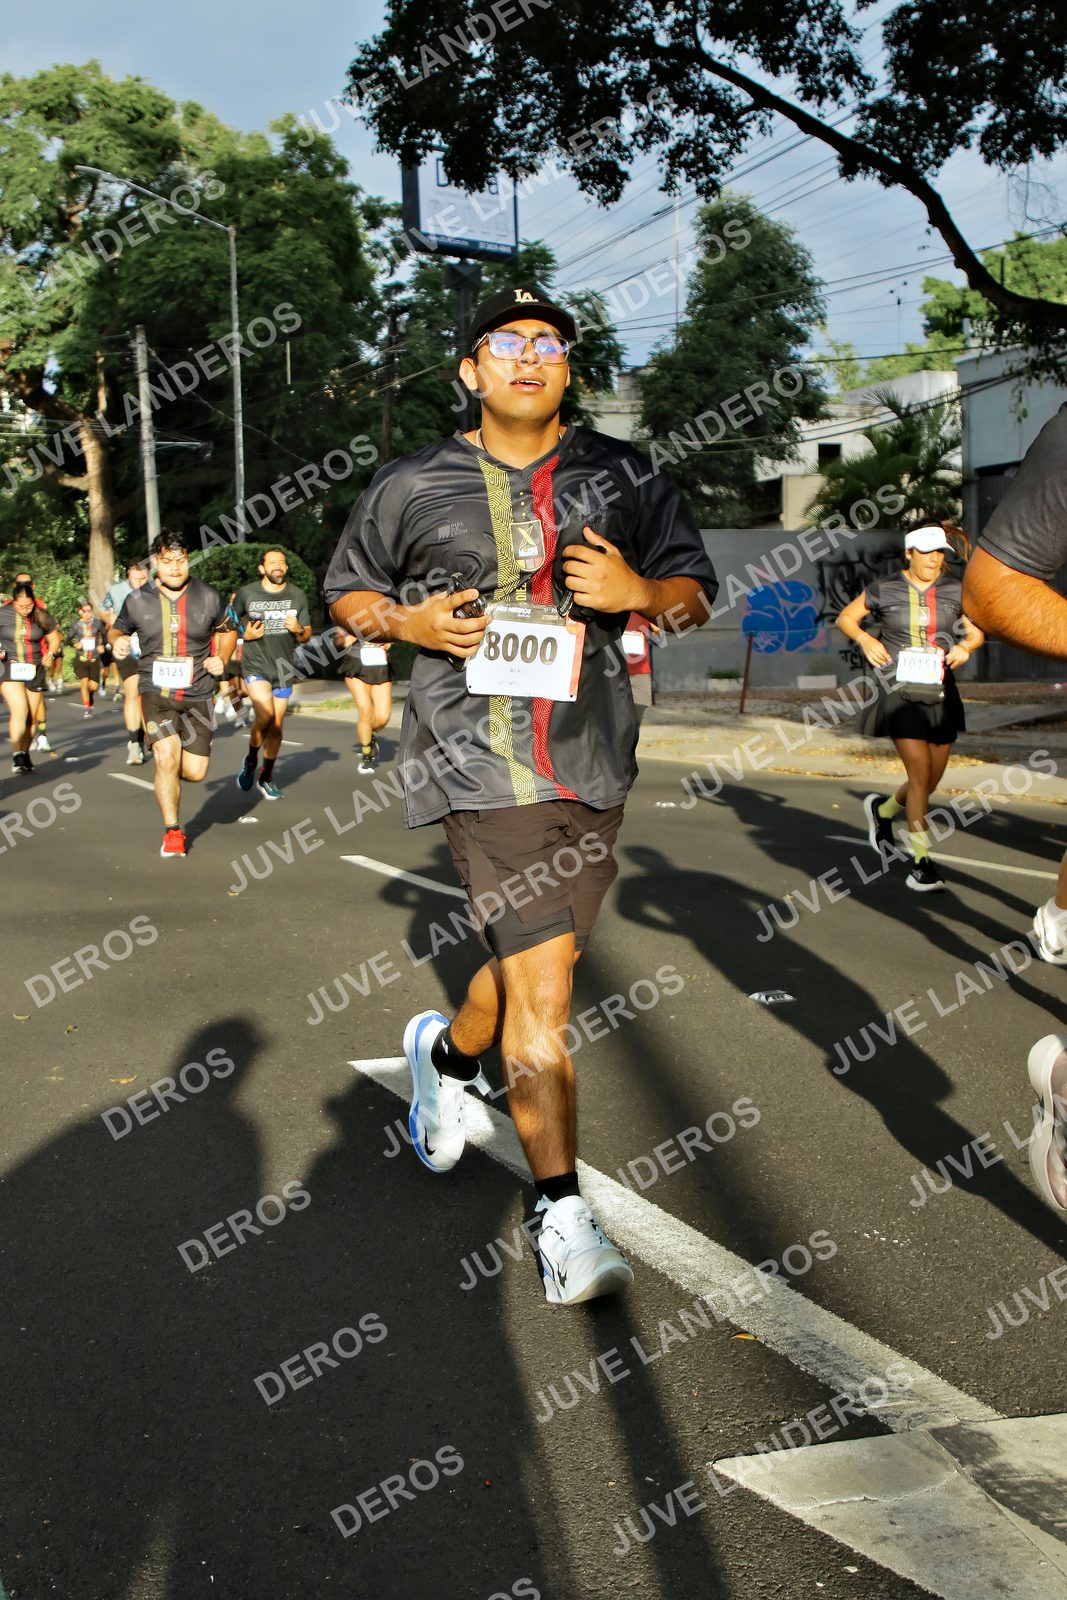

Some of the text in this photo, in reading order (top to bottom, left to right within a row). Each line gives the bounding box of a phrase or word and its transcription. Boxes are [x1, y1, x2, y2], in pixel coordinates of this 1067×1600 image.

[514, 289, 539, 303] LA
[249, 600, 292, 611] IGNITE
[484, 631, 558, 666] 8000
[159, 667, 184, 677] 8125
